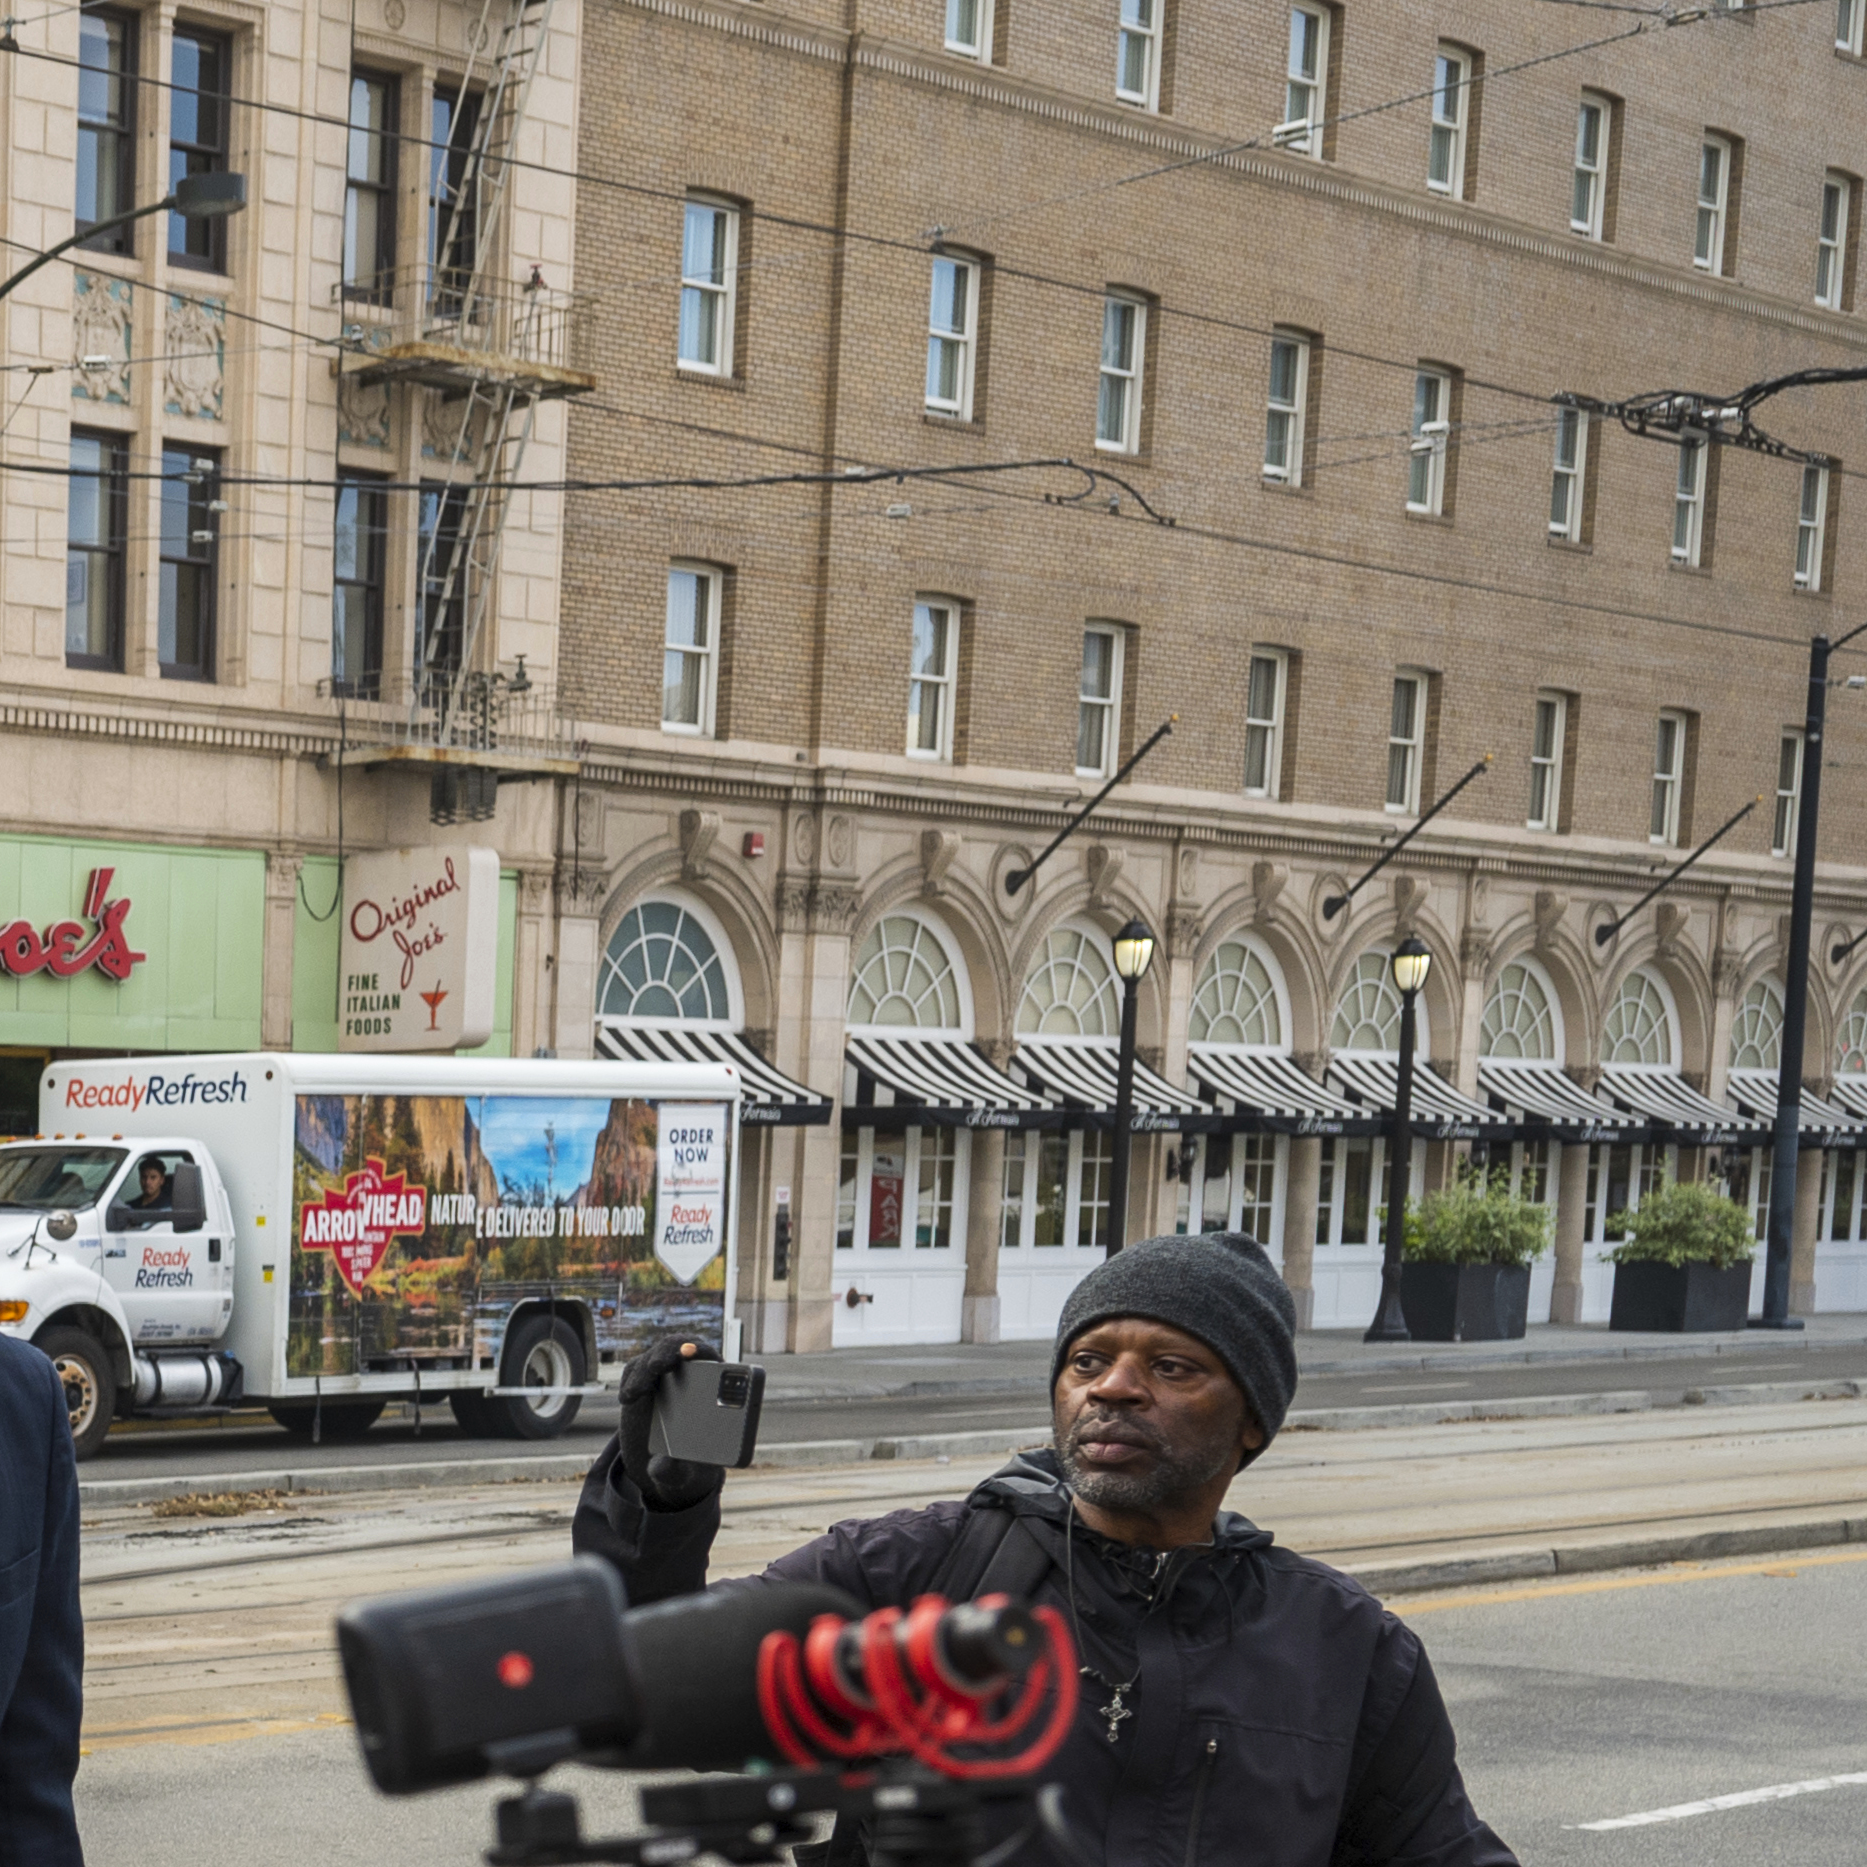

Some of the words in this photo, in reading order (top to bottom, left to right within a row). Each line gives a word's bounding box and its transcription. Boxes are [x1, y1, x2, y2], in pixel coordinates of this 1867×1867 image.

[350, 856, 461, 942] Original
[392, 922, 448, 990] Joe's
[347, 973, 379, 991] FINE
[346, 994, 401, 1013] ITALIAN
[346, 1017, 392, 1036] FOODS
[66, 1071, 247, 1112] ReadyRefresh
[669, 1129, 714, 1144] ORDER
[674, 1148, 709, 1162] NOW
[303, 1193, 423, 1243] ARROWHEAD
[485, 1206, 556, 1238] DELIVERED
[559, 1206, 574, 1238] TO
[577, 1206, 609, 1237] YOUR
[611, 1206, 645, 1236] DOOR
[671, 1202, 712, 1225] Ready
[663, 1225, 713, 1245] Refresh
[142, 1247, 191, 1269] Ready
[135, 1267, 193, 1288] Refresh
